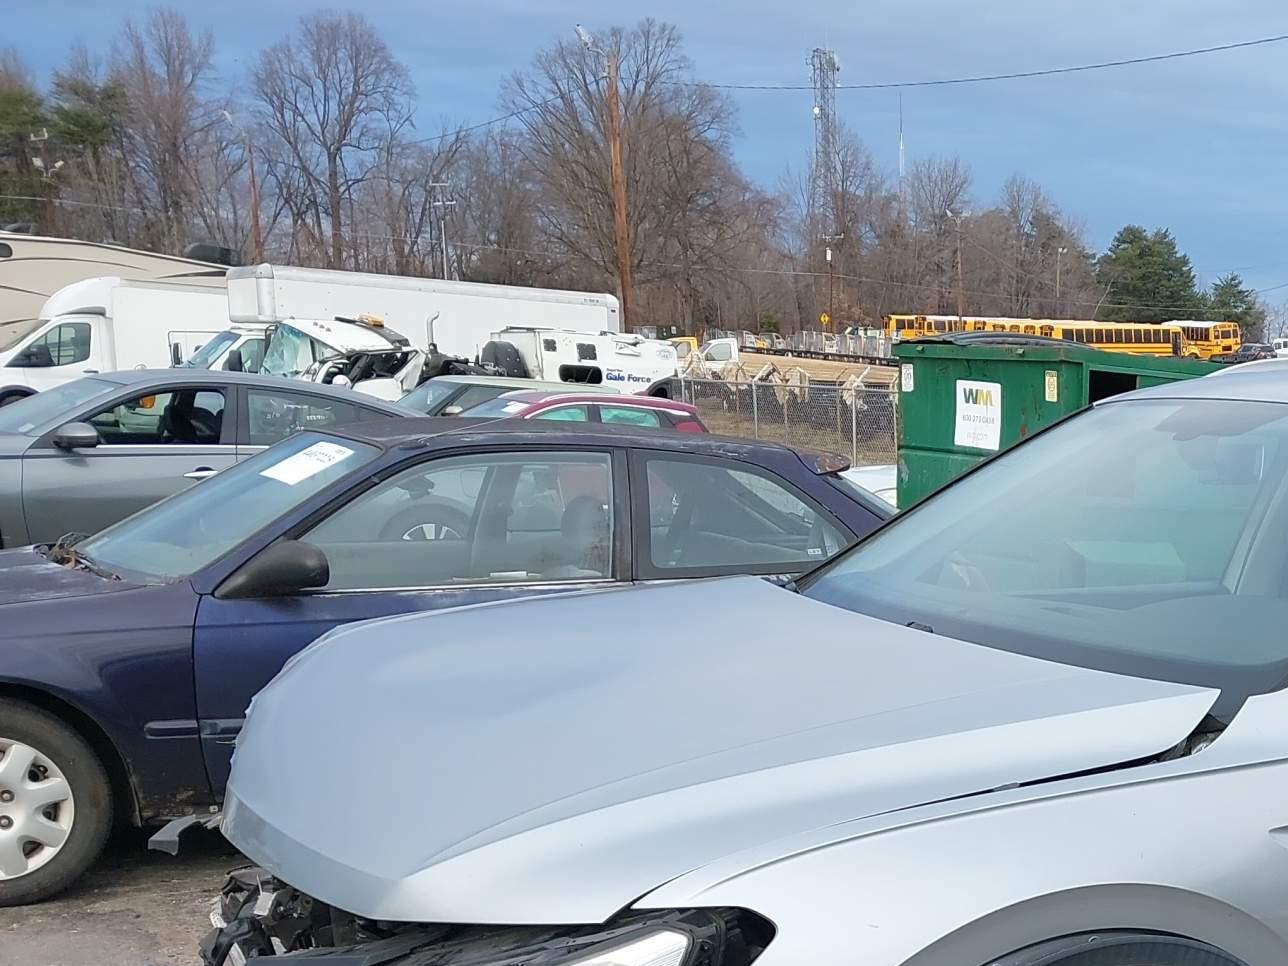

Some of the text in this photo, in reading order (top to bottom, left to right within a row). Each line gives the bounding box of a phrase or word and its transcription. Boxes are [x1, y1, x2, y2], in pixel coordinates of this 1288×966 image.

[606, 372, 651, 383] Gale Force
[963, 387, 994, 406] WM
